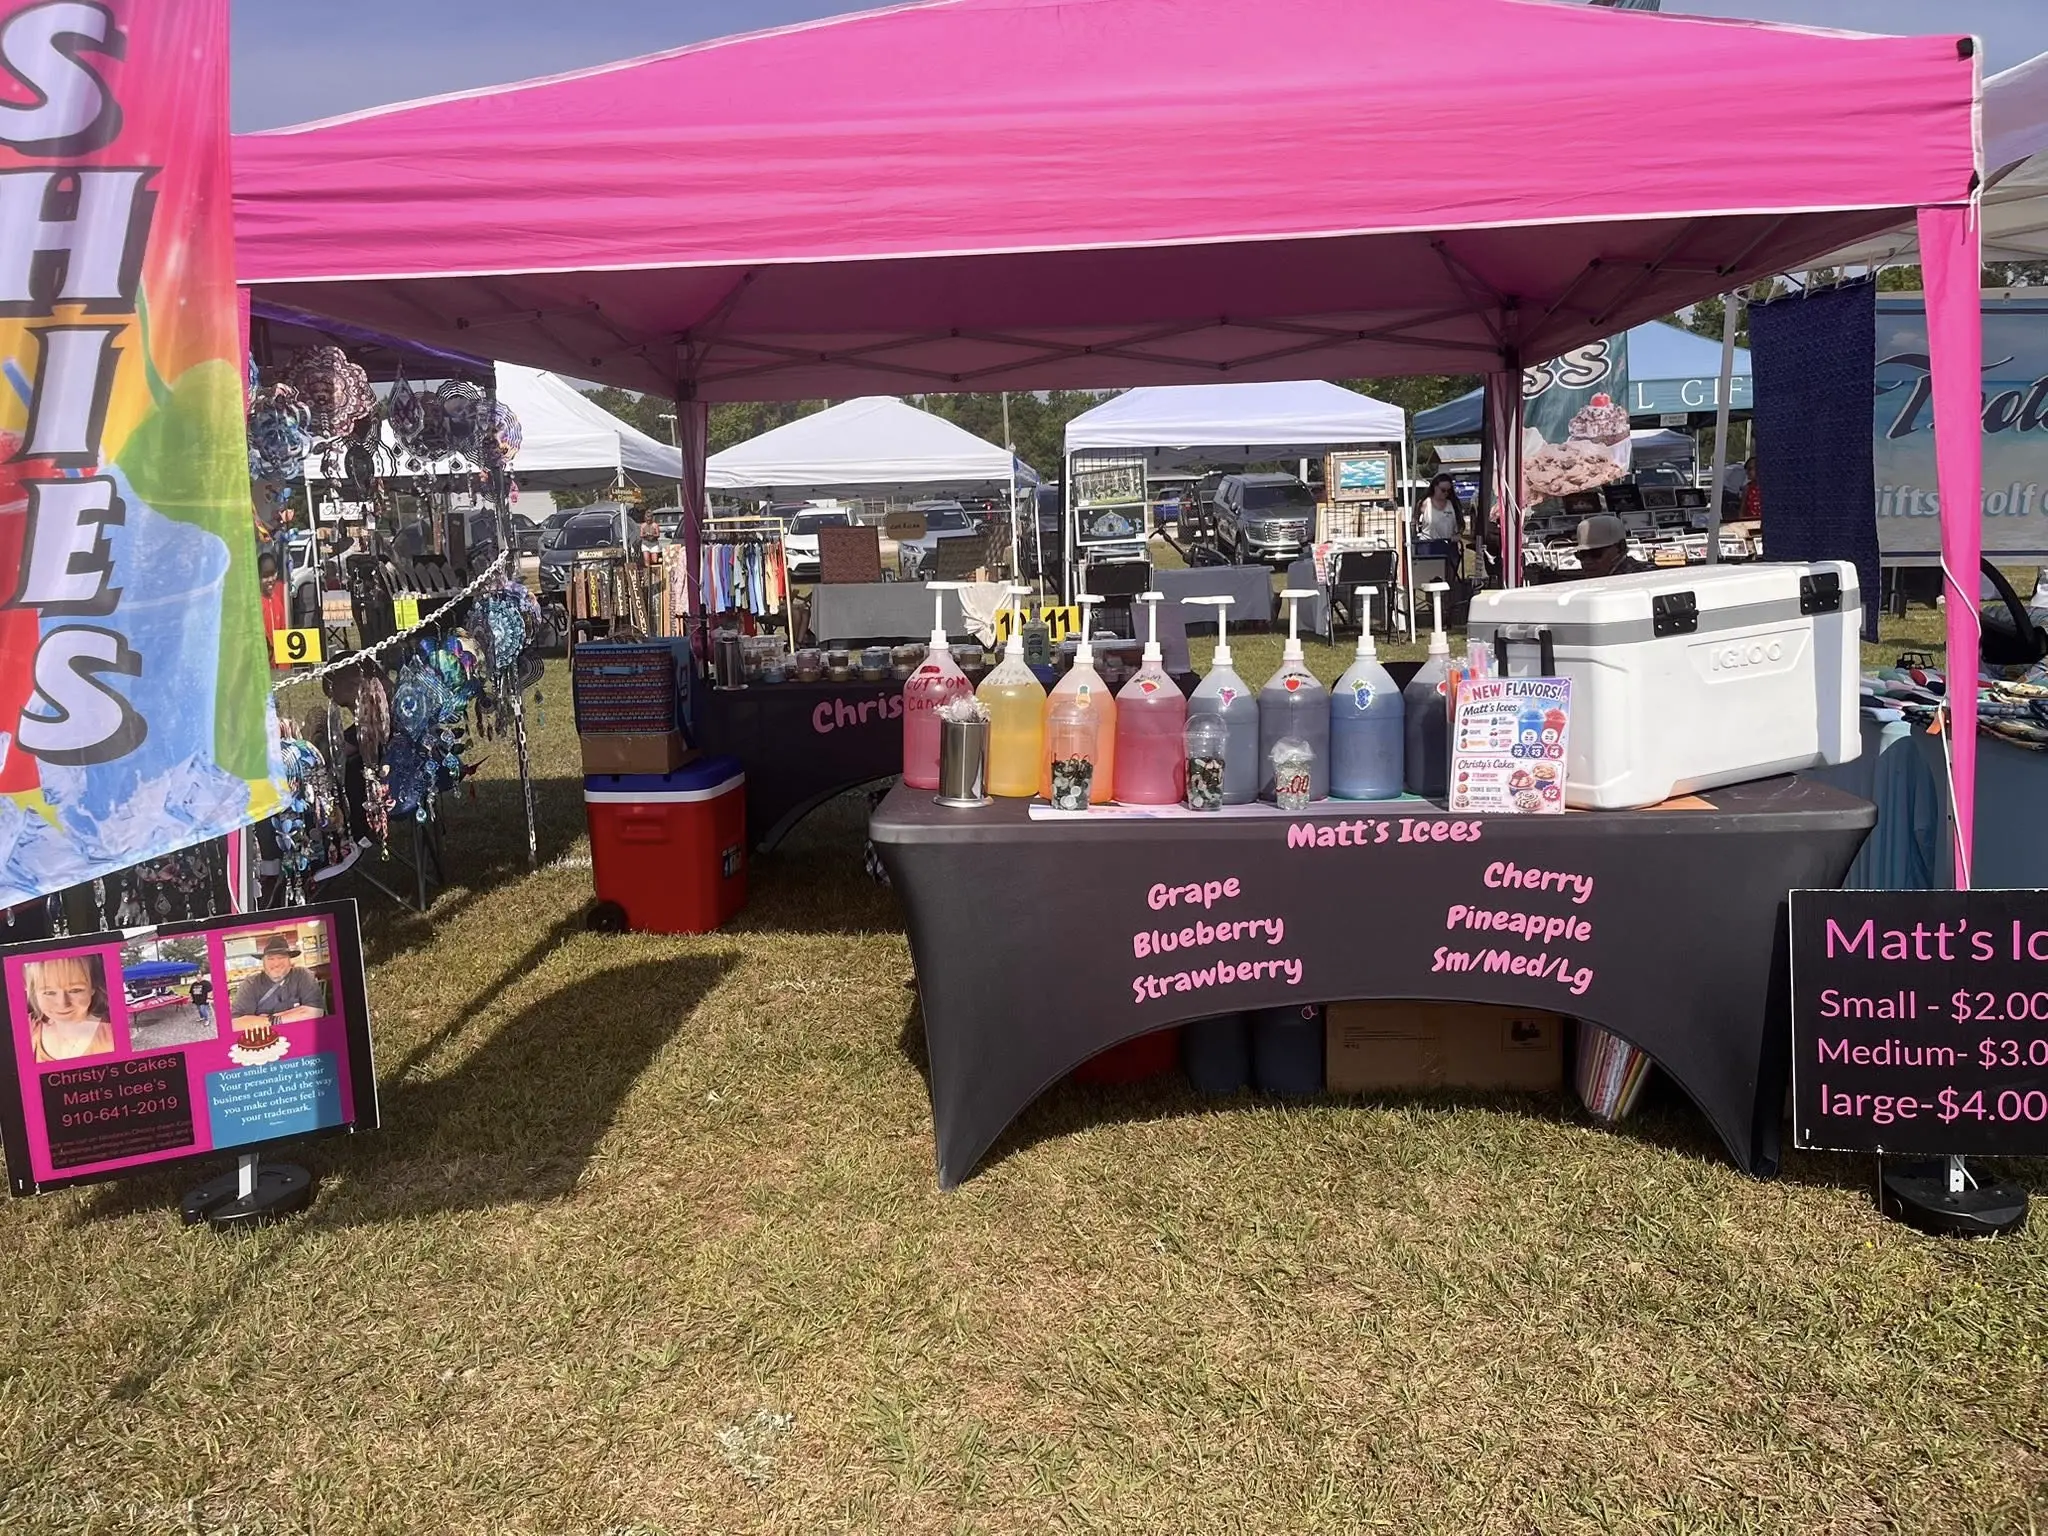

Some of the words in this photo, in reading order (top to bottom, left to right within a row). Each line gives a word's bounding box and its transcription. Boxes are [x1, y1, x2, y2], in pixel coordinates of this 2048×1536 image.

[1681, 376, 1753, 406] GIF
[1875, 484, 1940, 516] ifts
[1981, 480, 2038, 516] olf
[1045, 609, 1071, 638] 11
[287, 631, 307, 660] 9
[906, 676, 966, 692] COTTON
[1472, 684, 1501, 701] NEW
[1505, 682, 1562, 699] FLAVORS!
[908, 695, 947, 712] Cand
[1463, 703, 1495, 716] Matt's
[1496, 703, 1517, 713] Icees
[1458, 760, 1491, 770] Christy's
[1493, 759, 1515, 769] Cakes
[1287, 819, 1390, 849] Matt's
[1397, 818, 1483, 843] Icees
[1147, 877, 1241, 910] Grape
[1483, 862, 1594, 904] Cherry
[1133, 917, 1284, 959] Blueberry
[1446, 905, 1593, 944] Pineapple
[1825, 918, 1995, 961] Matt's
[1132, 958, 1303, 1004] Strawberry
[1431, 946, 1594, 995] Sm/Med/Lg
[1819, 989, 1917, 1020] Small
[1817, 1038, 1968, 1067] Medium-
[47, 1066, 120, 1087] Christy's
[124, 1057, 177, 1075] Cakes
[219, 1072, 241, 1081] Your
[243, 1065, 267, 1077] smile
[270, 1064, 277, 1072] is
[279, 1062, 299, 1073] your
[219, 1083, 241, 1093] Your
[244, 1074, 293, 1090] personality
[295, 1071, 303, 1079] is
[304, 1067, 325, 1079] your
[63, 1088, 113, 1106] Matt's
[119, 1079, 167, 1097] Icee's
[213, 1093, 251, 1106] business
[253, 1088, 275, 1099] card.
[277, 1084, 297, 1094] And
[299, 1080, 313, 1090] the
[315, 1078, 332, 1087] way
[224, 1107, 241, 1117] you
[243, 1101, 267, 1112] make
[270, 1094, 297, 1106] others
[299, 1090, 316, 1100] feel
[62, 1096, 178, 1127] 910-641-2019
[241, 1114, 262, 1126] your
[264, 1103, 311, 1119] trademark.
